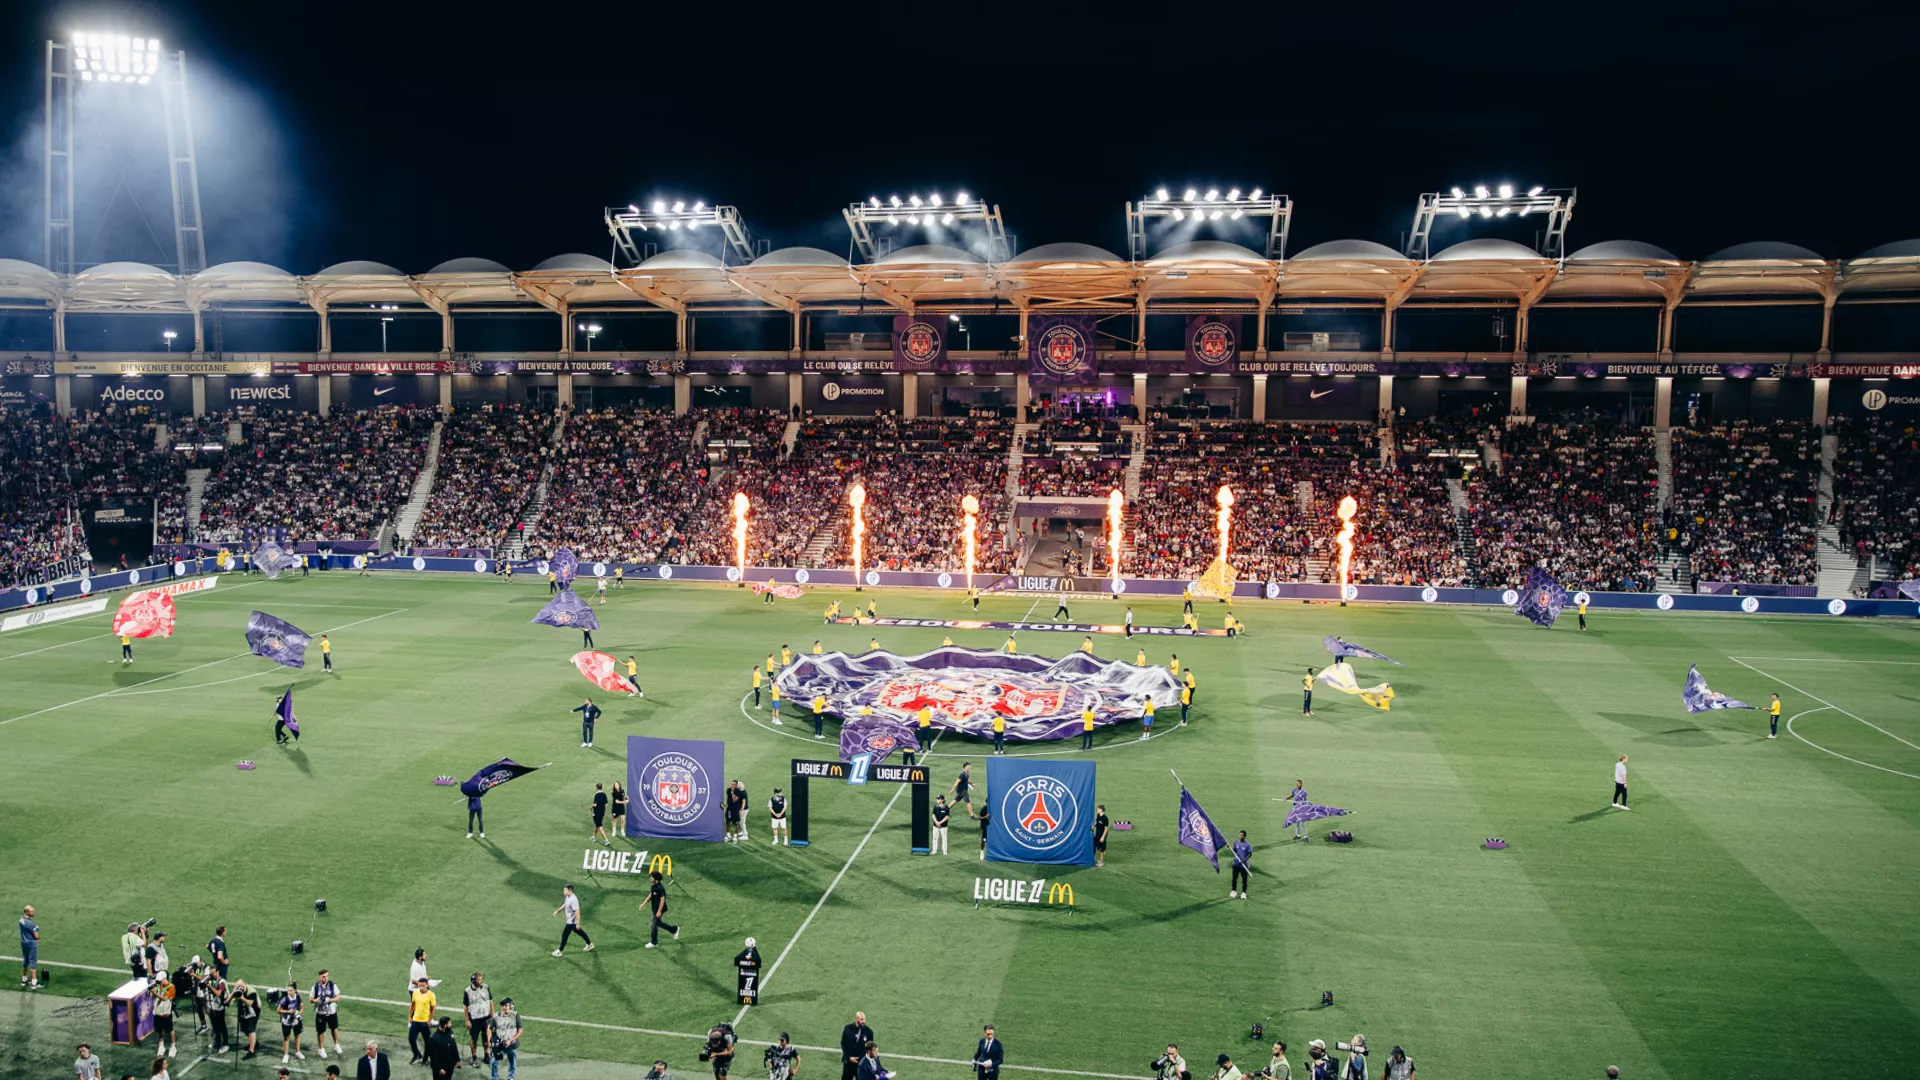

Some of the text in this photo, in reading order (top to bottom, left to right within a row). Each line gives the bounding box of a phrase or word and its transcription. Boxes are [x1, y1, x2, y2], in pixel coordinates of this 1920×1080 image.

[1047, 328, 1077, 338] TOULOUSE
[1200, 325, 1227, 334] TOULOUSE
[564, 361, 569, 370] À
[865, 360, 894, 369] RELÈVE
[1045, 357, 1080, 370] FOOTBALL CLUB
[1294, 361, 1326, 371] RELÈVE
[1608, 364, 1722, 375] BIENVENUE AU TÉFÉCÉ.
[1828, 366, 1890, 375] BIENVENUE
[101, 385, 164, 401] Adecco
[230, 384, 291, 399] newrest
[1018, 577, 1049, 591] LIGUE
[652, 756, 698, 774] TOULOUSE
[797, 763, 821, 775] LIGUE
[877, 768, 902, 780] LIGUE
[1015, 779, 1065, 798] PARIS
[648, 799, 700, 821] FOOTBALL CLUB
[1015, 828, 1064, 844] SAINT GERMAIN
[583, 849, 631, 873] LIGUE
[974, 878, 1026, 902] LIGUE
